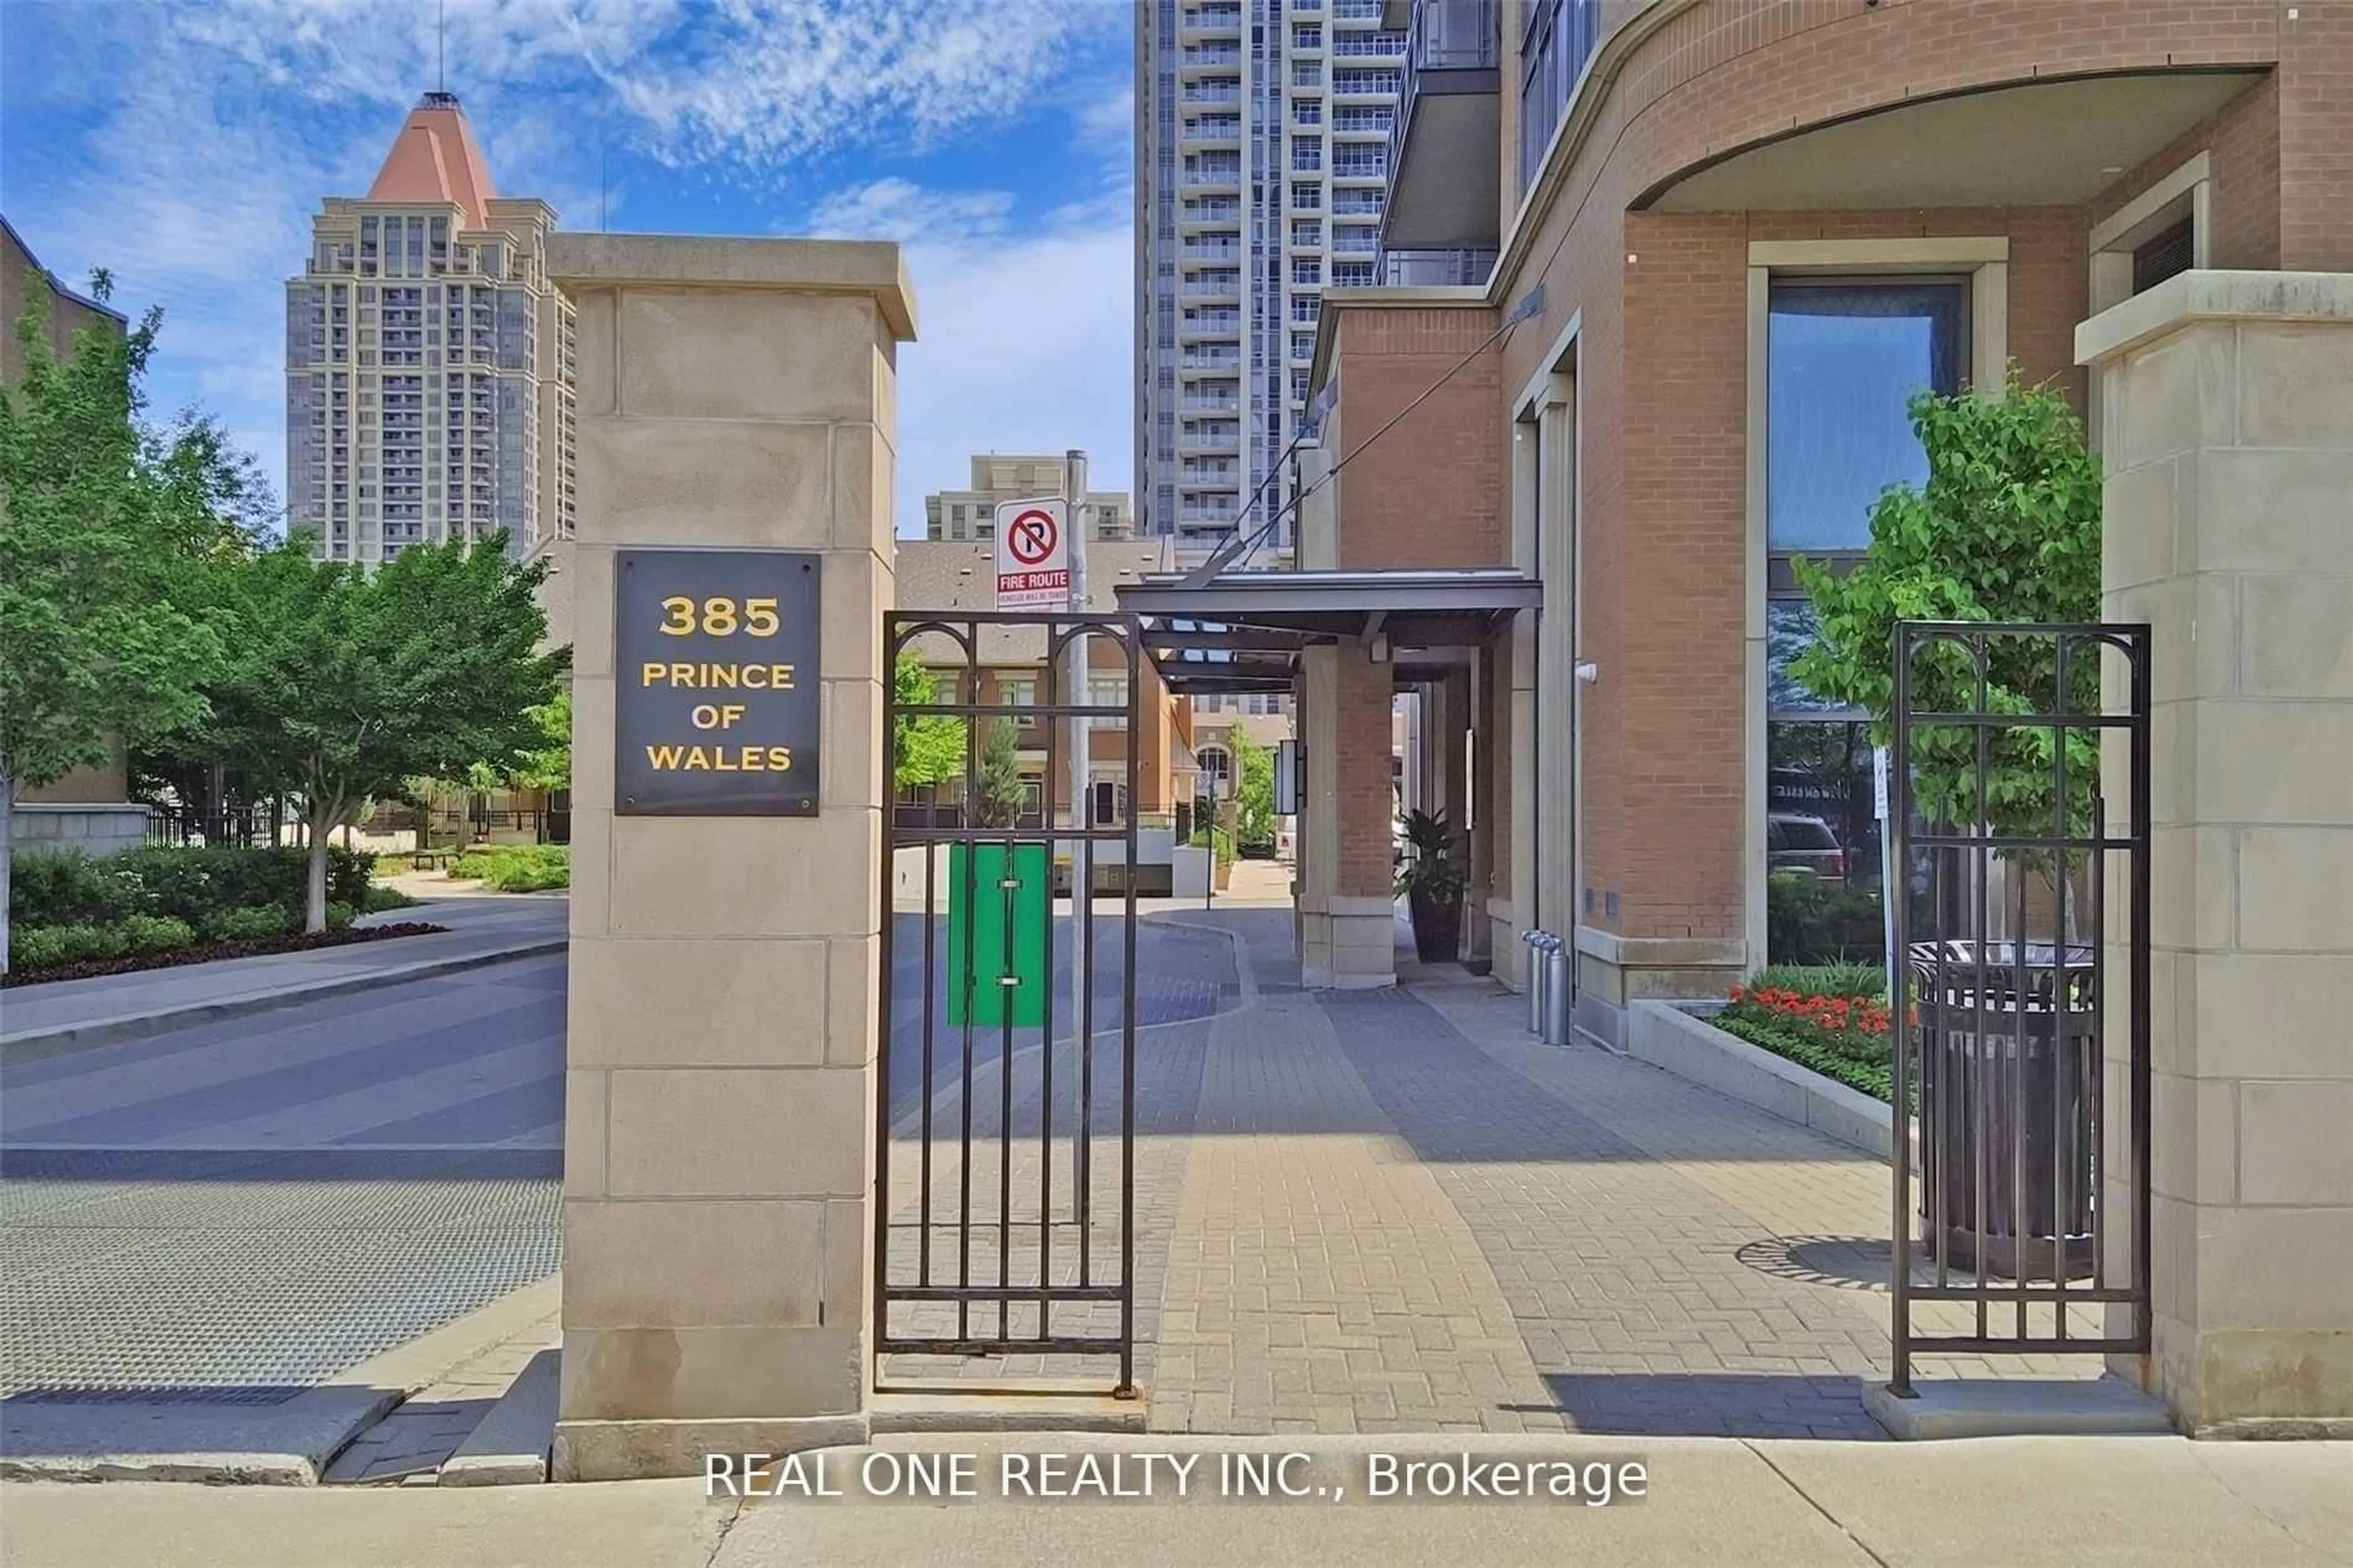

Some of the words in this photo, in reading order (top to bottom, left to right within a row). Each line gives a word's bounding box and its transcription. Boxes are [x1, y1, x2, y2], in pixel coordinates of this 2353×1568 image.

[1000, 575, 1026, 590] FIRE
[1029, 572, 1067, 587] ROUTE
[657, 594, 781, 637] 385
[642, 663, 795, 689] PRINCE
[691, 704, 746, 729] OF
[645, 745, 792, 771] WALES
